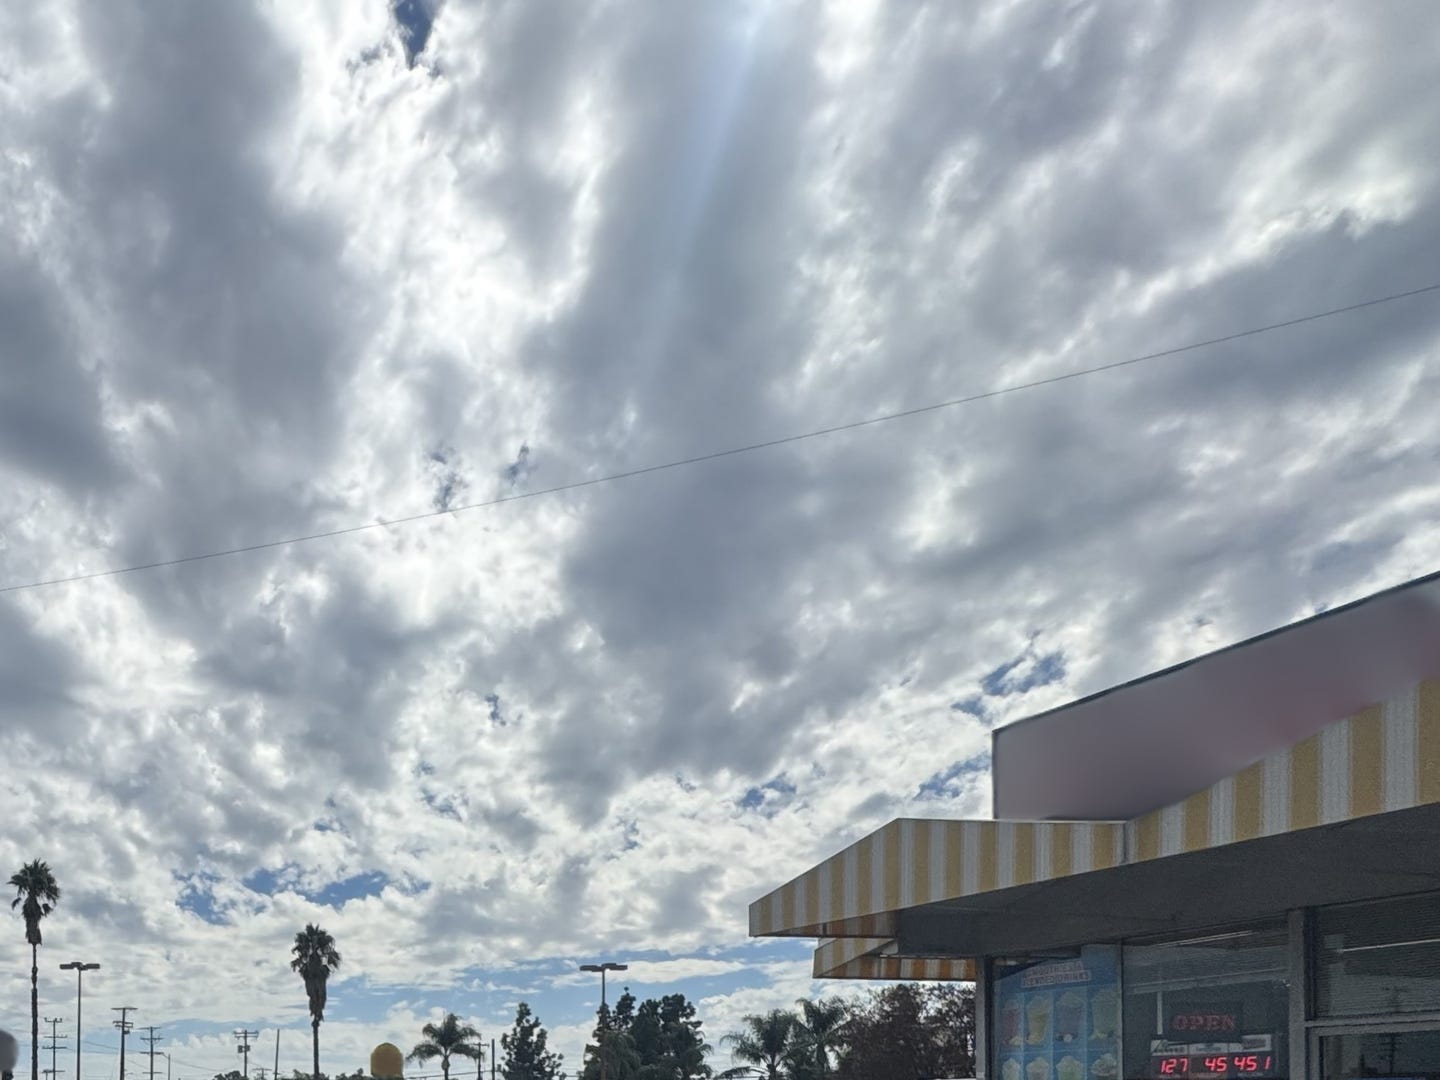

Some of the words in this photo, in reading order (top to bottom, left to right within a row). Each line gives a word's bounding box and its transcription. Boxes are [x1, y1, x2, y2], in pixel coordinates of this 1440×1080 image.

[1173, 1014, 1235, 1031] OPEN
[1160, 1058, 1189, 1074] 127
[1205, 1057, 1228, 1072] 45
